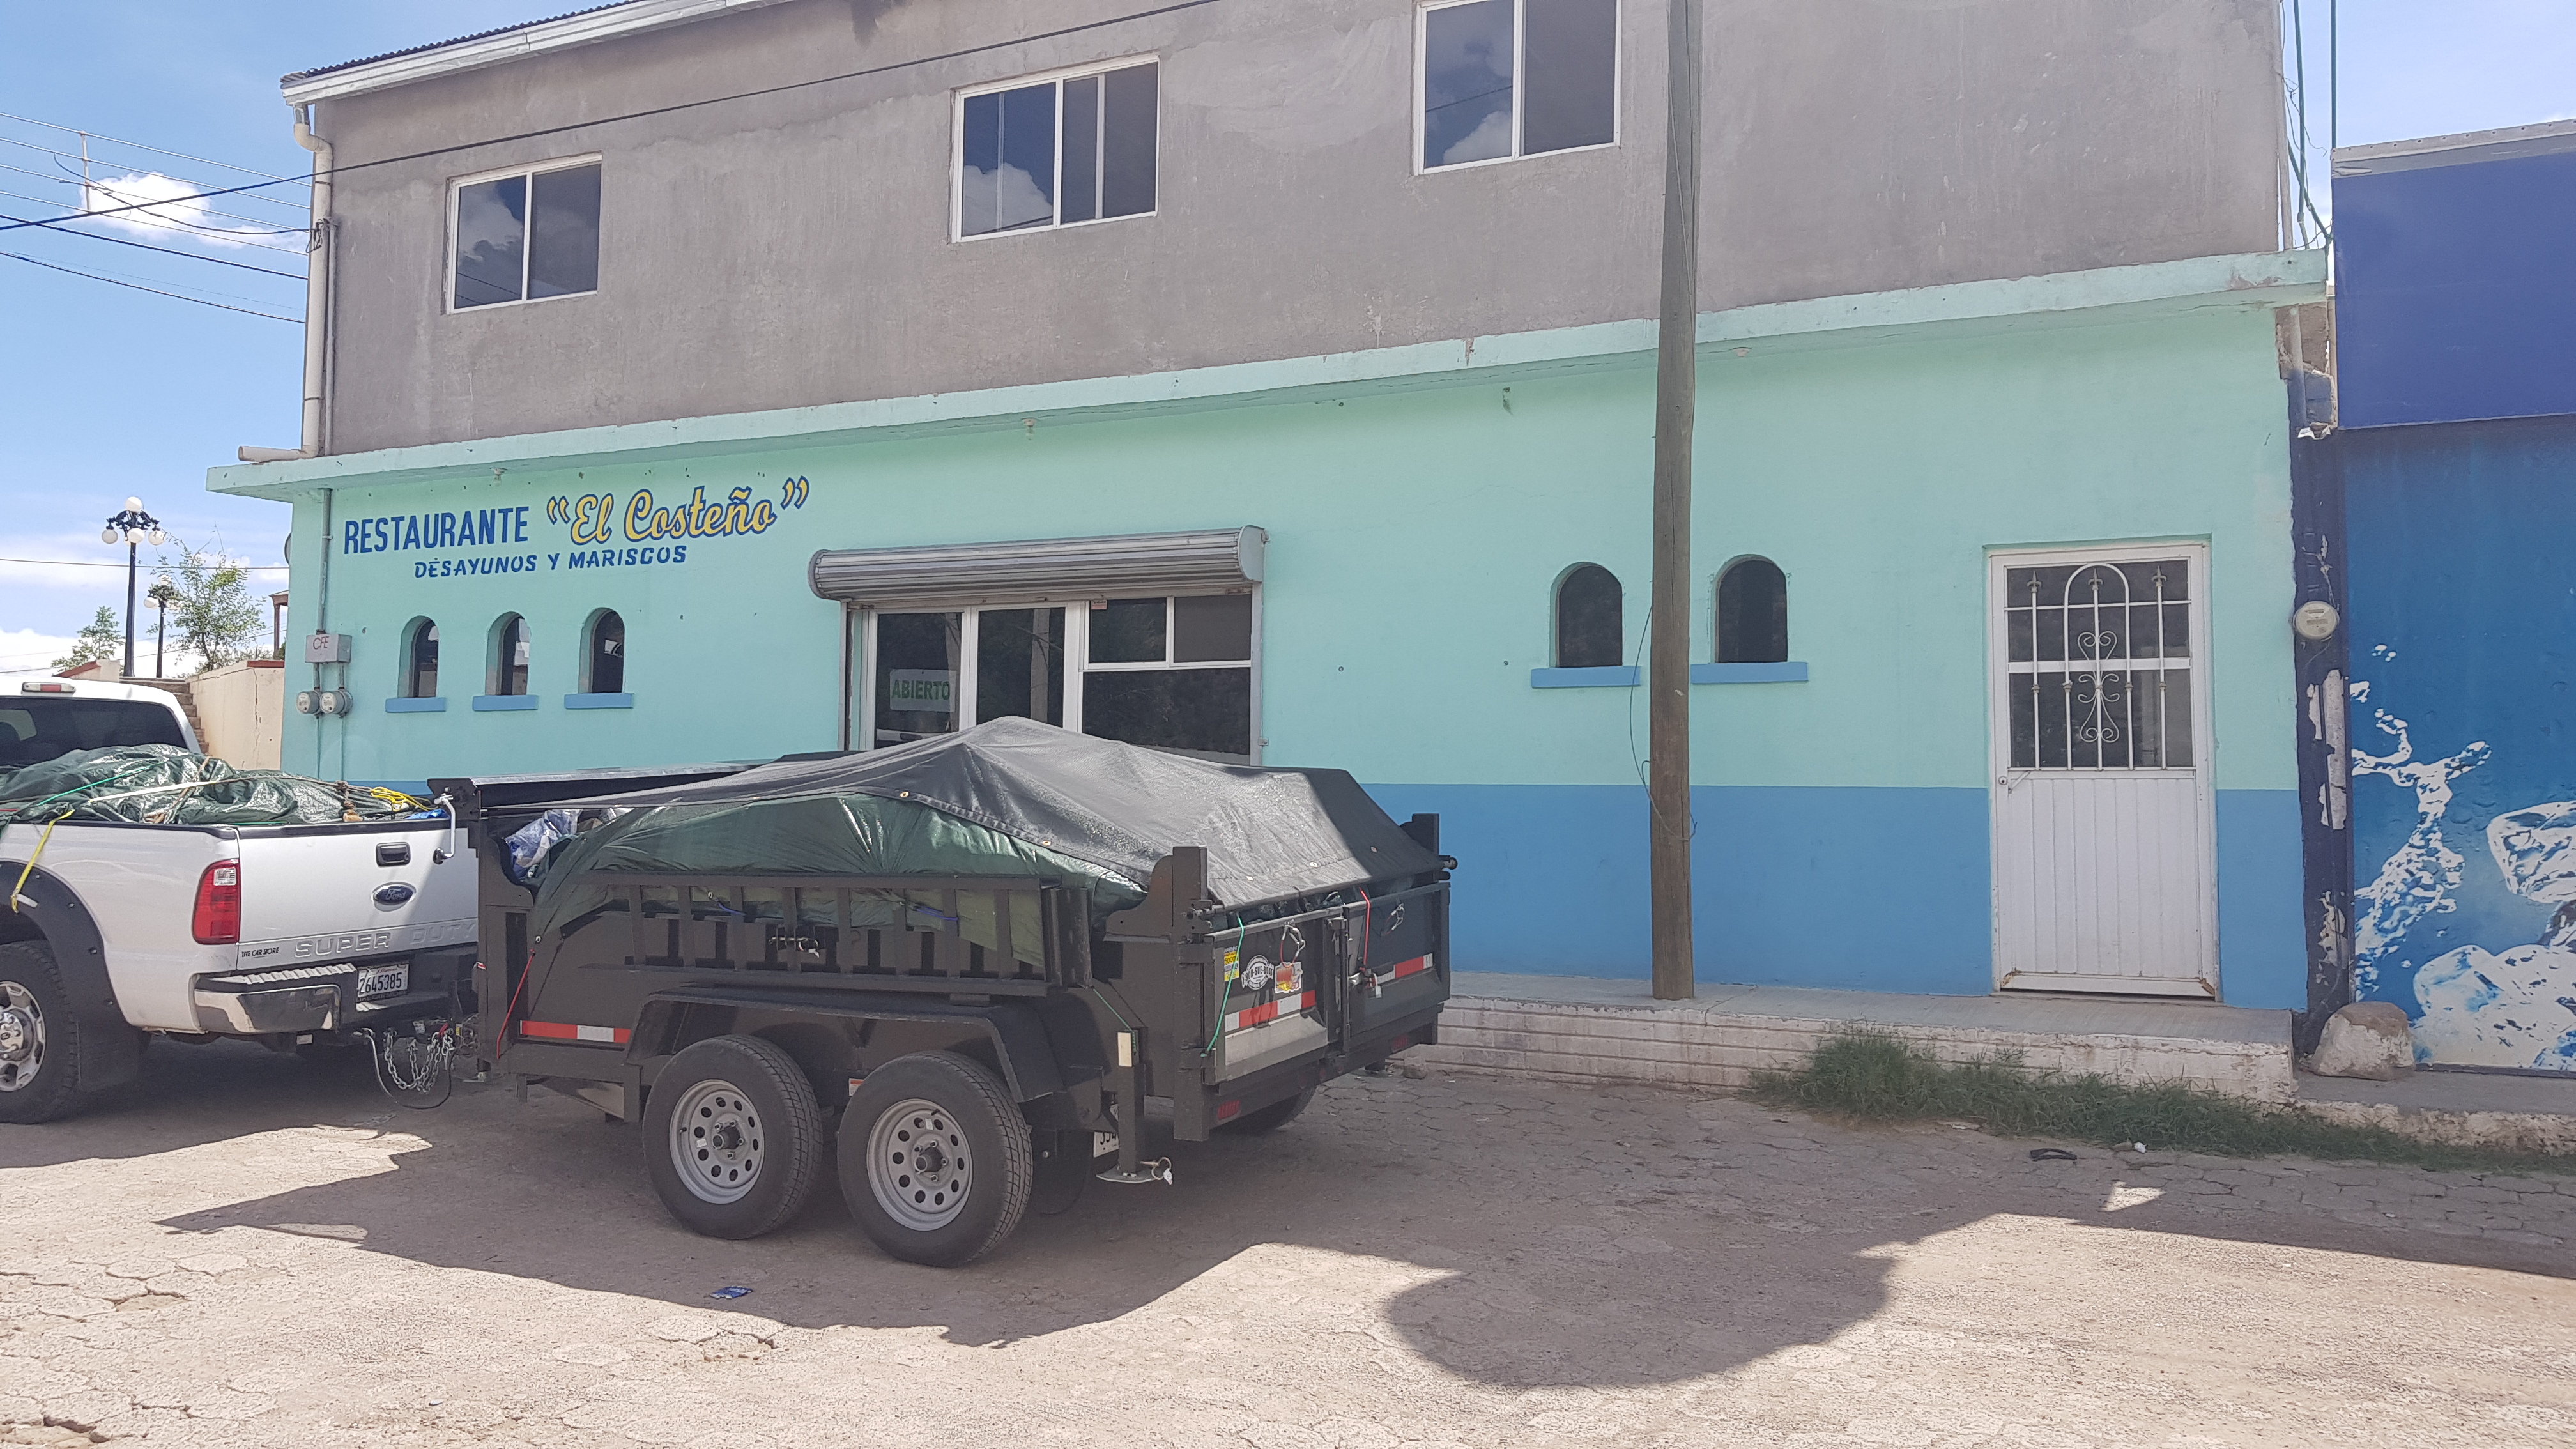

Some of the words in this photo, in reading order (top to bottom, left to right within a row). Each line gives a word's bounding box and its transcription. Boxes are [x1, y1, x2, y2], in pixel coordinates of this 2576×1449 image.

[344, 505, 529, 555] RESTAURANTE
[414, 555, 537, 578] DESAYUNOS
[548, 553, 560, 570] Y
[569, 545, 687, 569] MARISCOS
[312, 636, 330, 650] CFE
[891, 680, 950, 700] ABIERTO
[385, 888, 406, 900] Ford
[295, 932, 392, 958] SUPER
[410, 922, 476, 945] DUTY
[359, 972, 402, 995] 2645385
